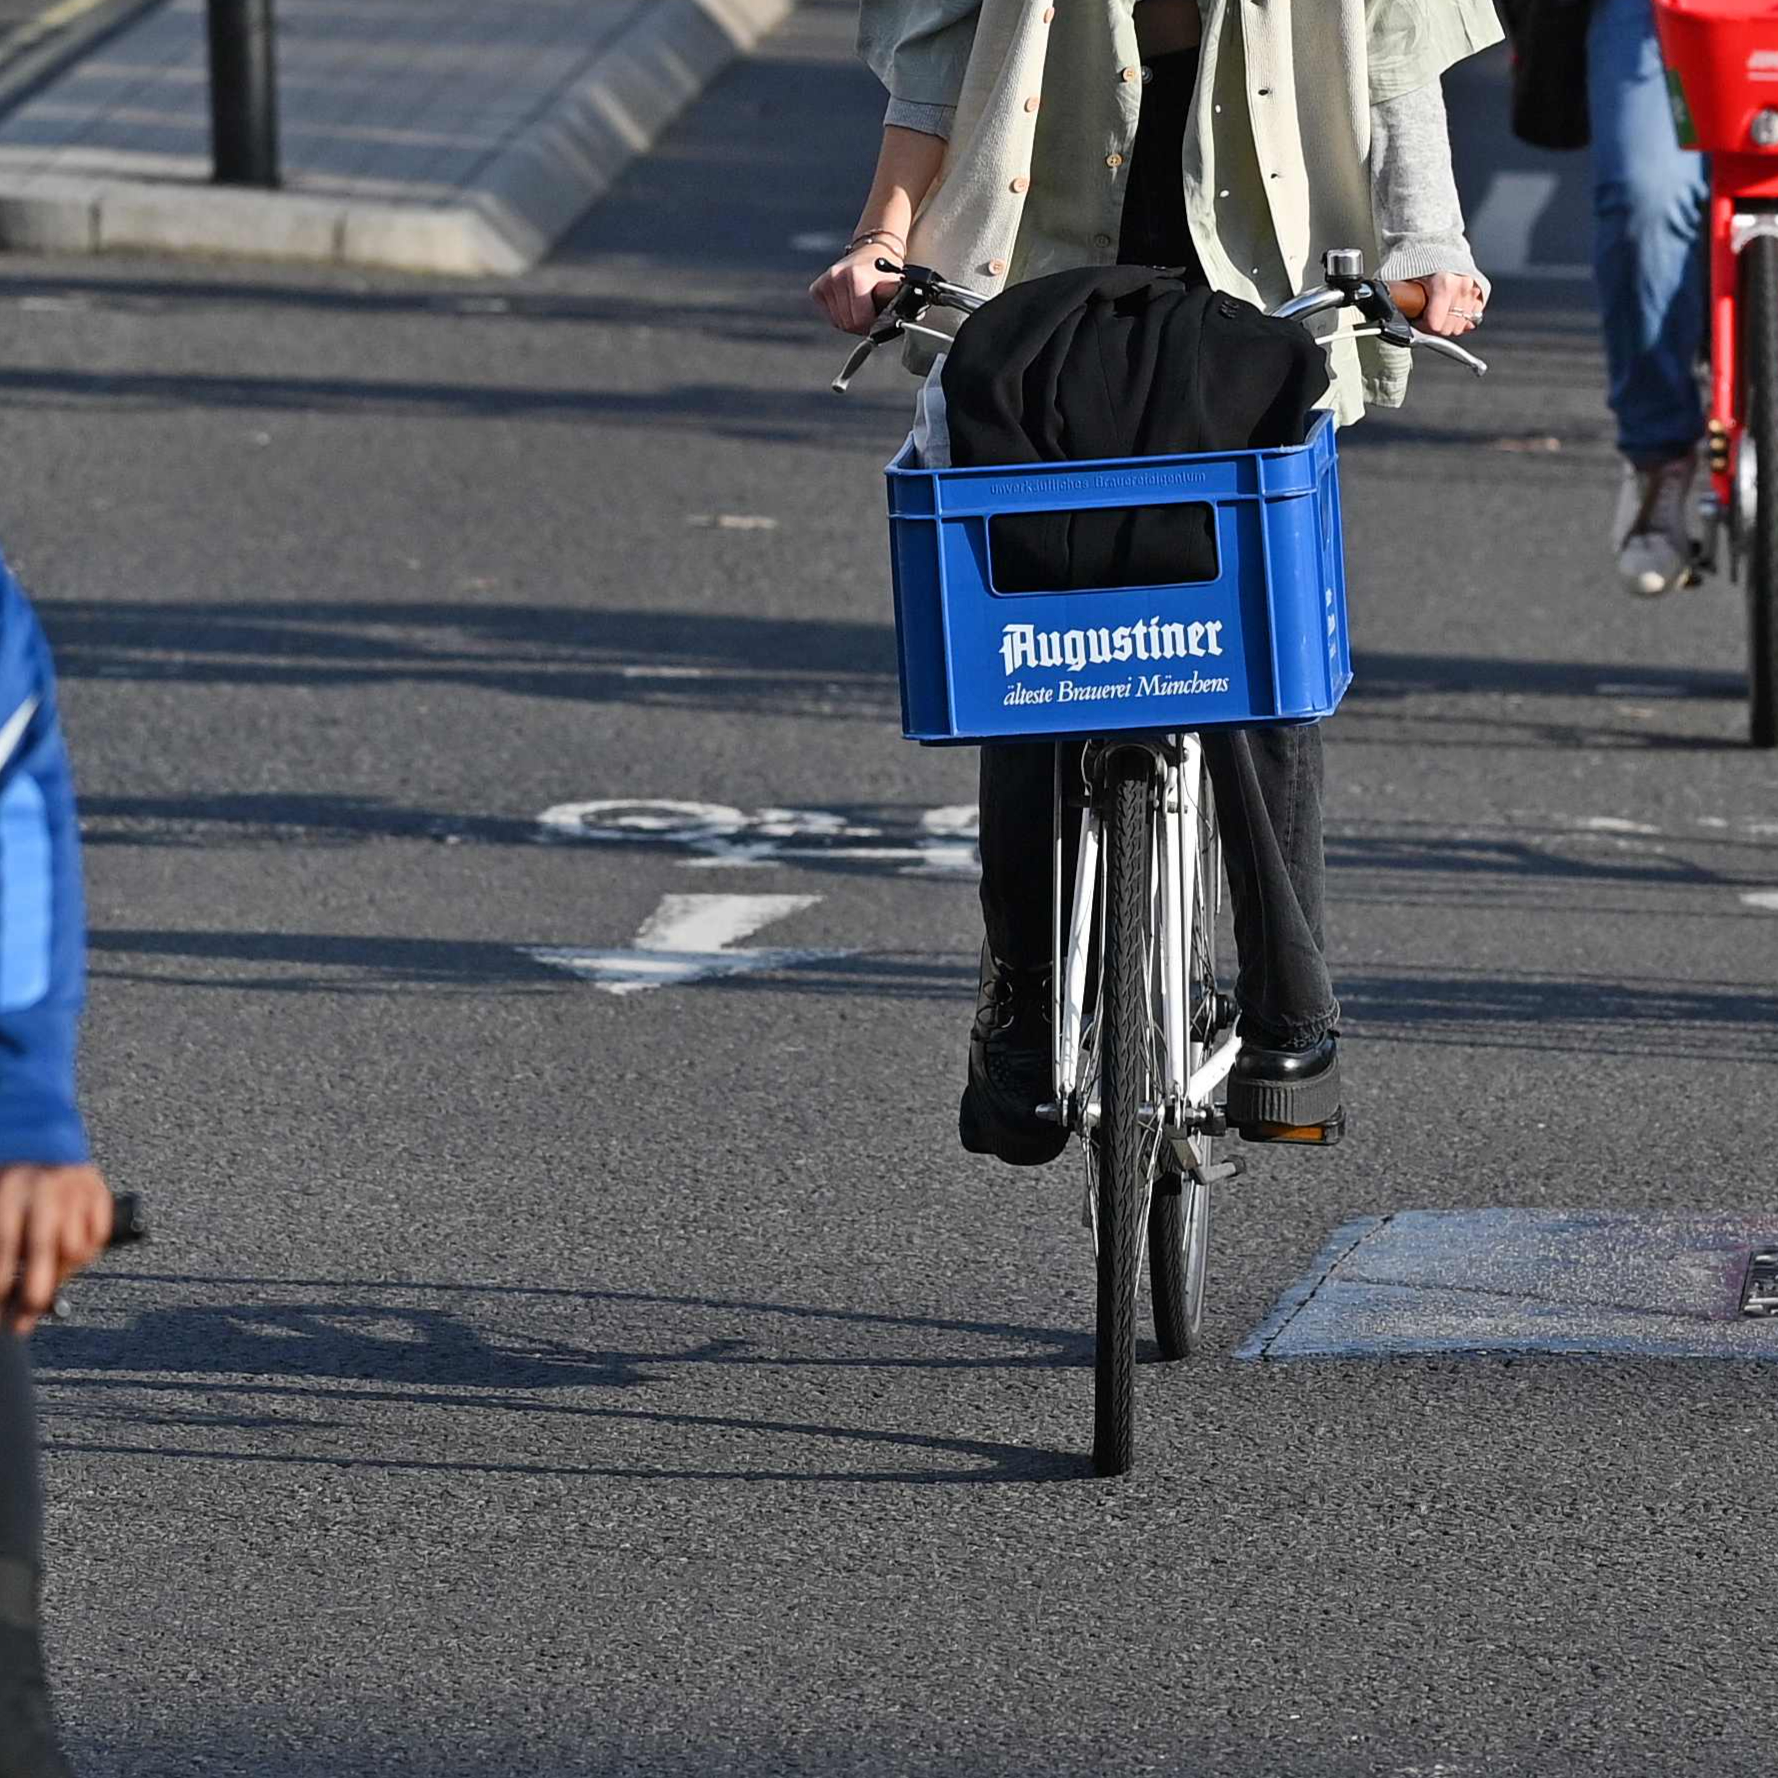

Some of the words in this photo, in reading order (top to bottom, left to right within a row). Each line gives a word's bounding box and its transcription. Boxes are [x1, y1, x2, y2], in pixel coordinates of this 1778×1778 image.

[999, 615, 1223, 677] Augustiner
[1003, 682, 1054, 706] älteste
[1057, 676, 1133, 703] Brauerei
[1134, 670, 1230, 698] Münchens
